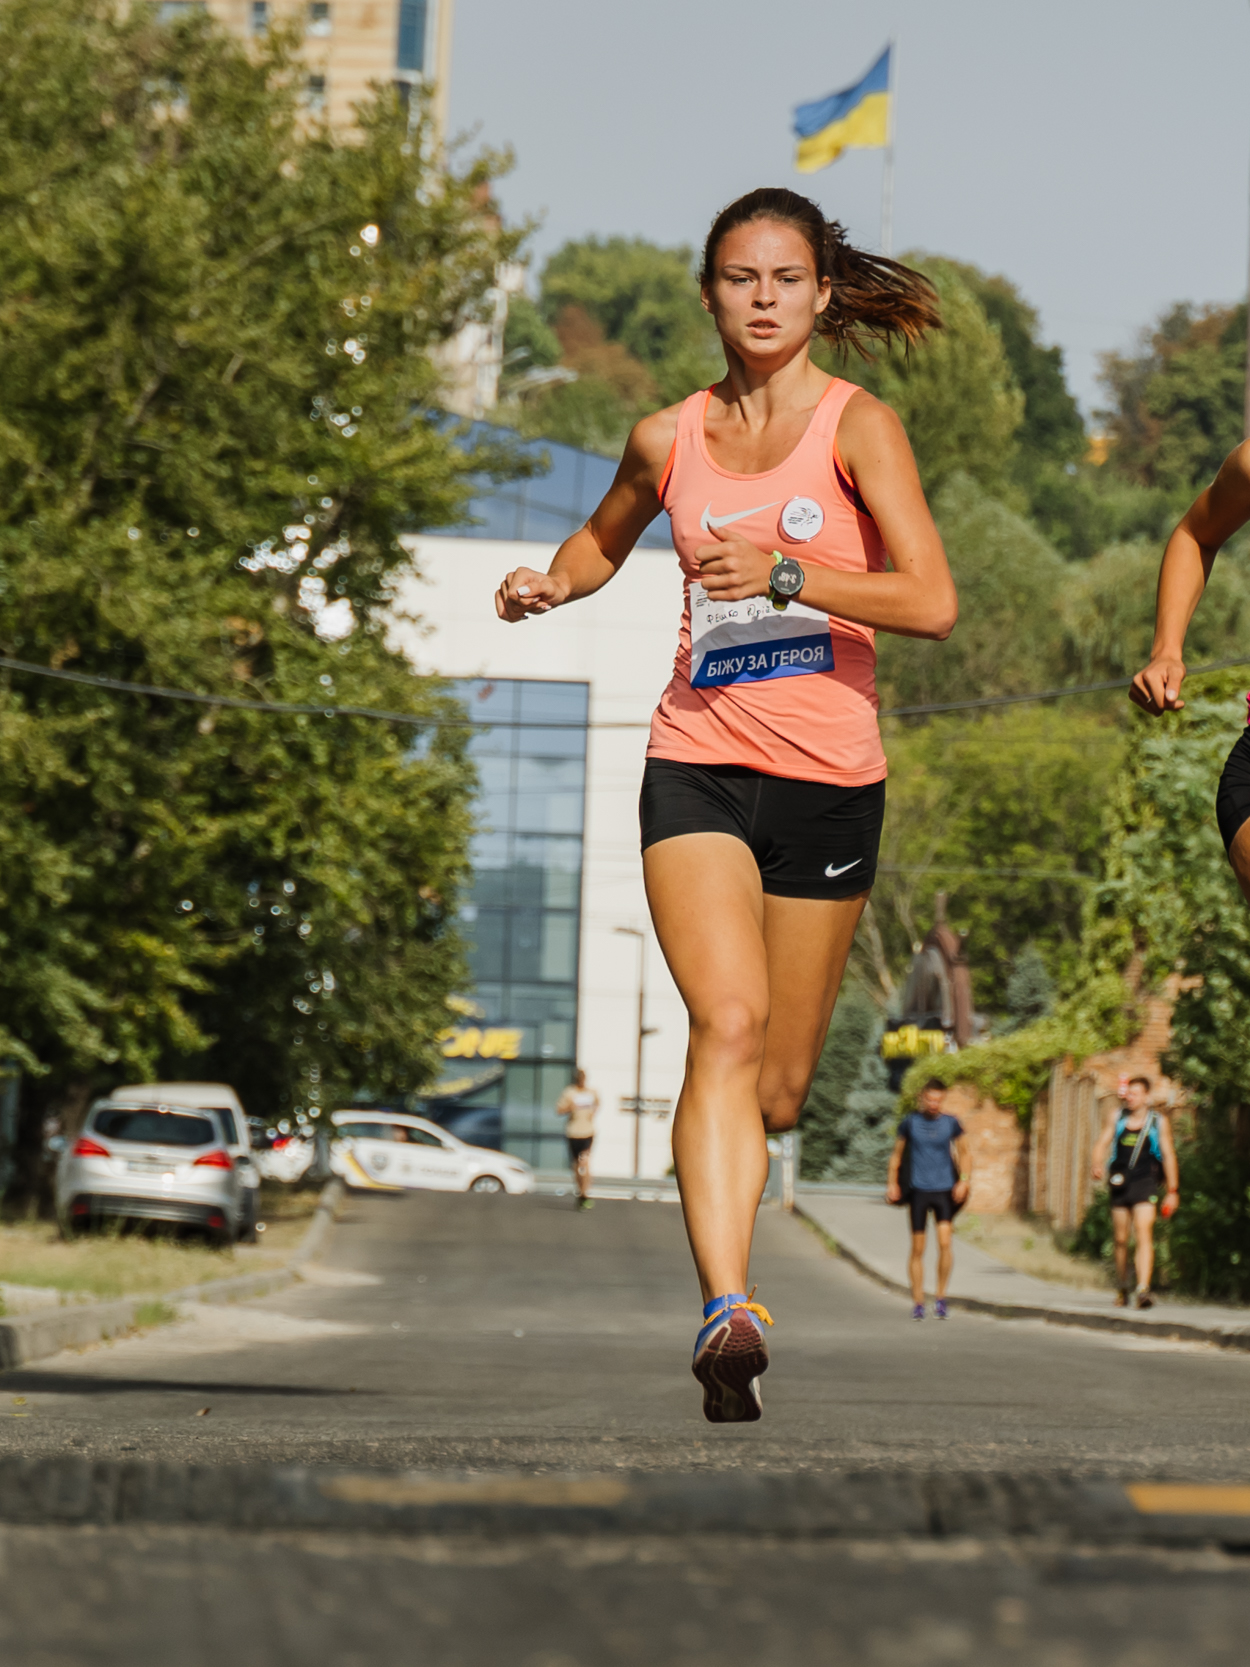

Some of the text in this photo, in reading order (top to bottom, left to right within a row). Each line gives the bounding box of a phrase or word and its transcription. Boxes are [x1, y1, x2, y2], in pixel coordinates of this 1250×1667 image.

[706, 645, 825, 677] БІЖУ ЗА ГЕРОЯ
